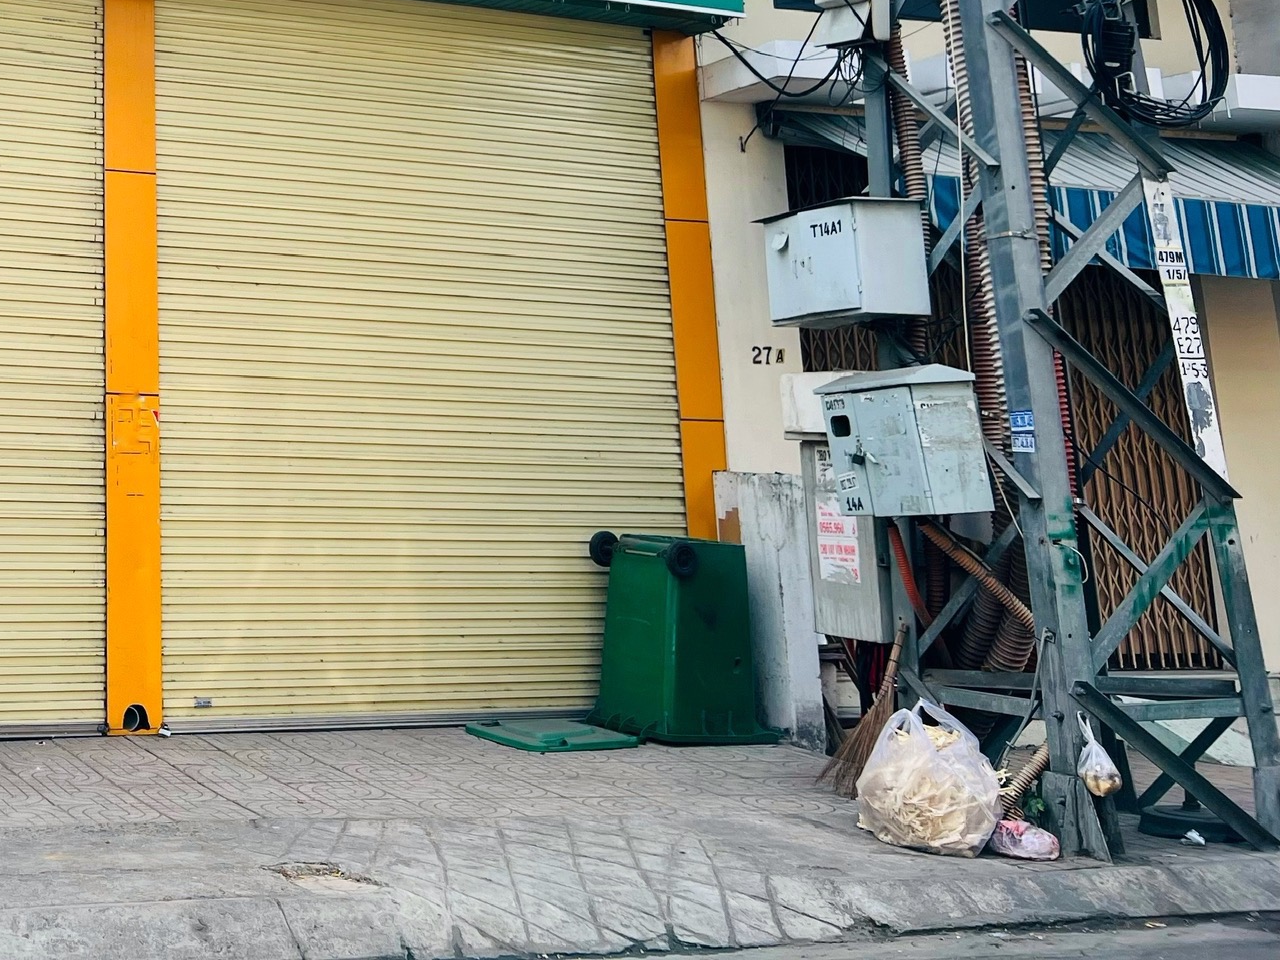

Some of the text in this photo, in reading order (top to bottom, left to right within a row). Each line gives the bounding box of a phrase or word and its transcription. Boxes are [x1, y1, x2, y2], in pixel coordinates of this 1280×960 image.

[810, 219, 842, 238] T14A1
[1158, 251, 1184, 263] 479M
[1173, 316, 1199, 334] 479
[847, 497, 864, 511] 14A
